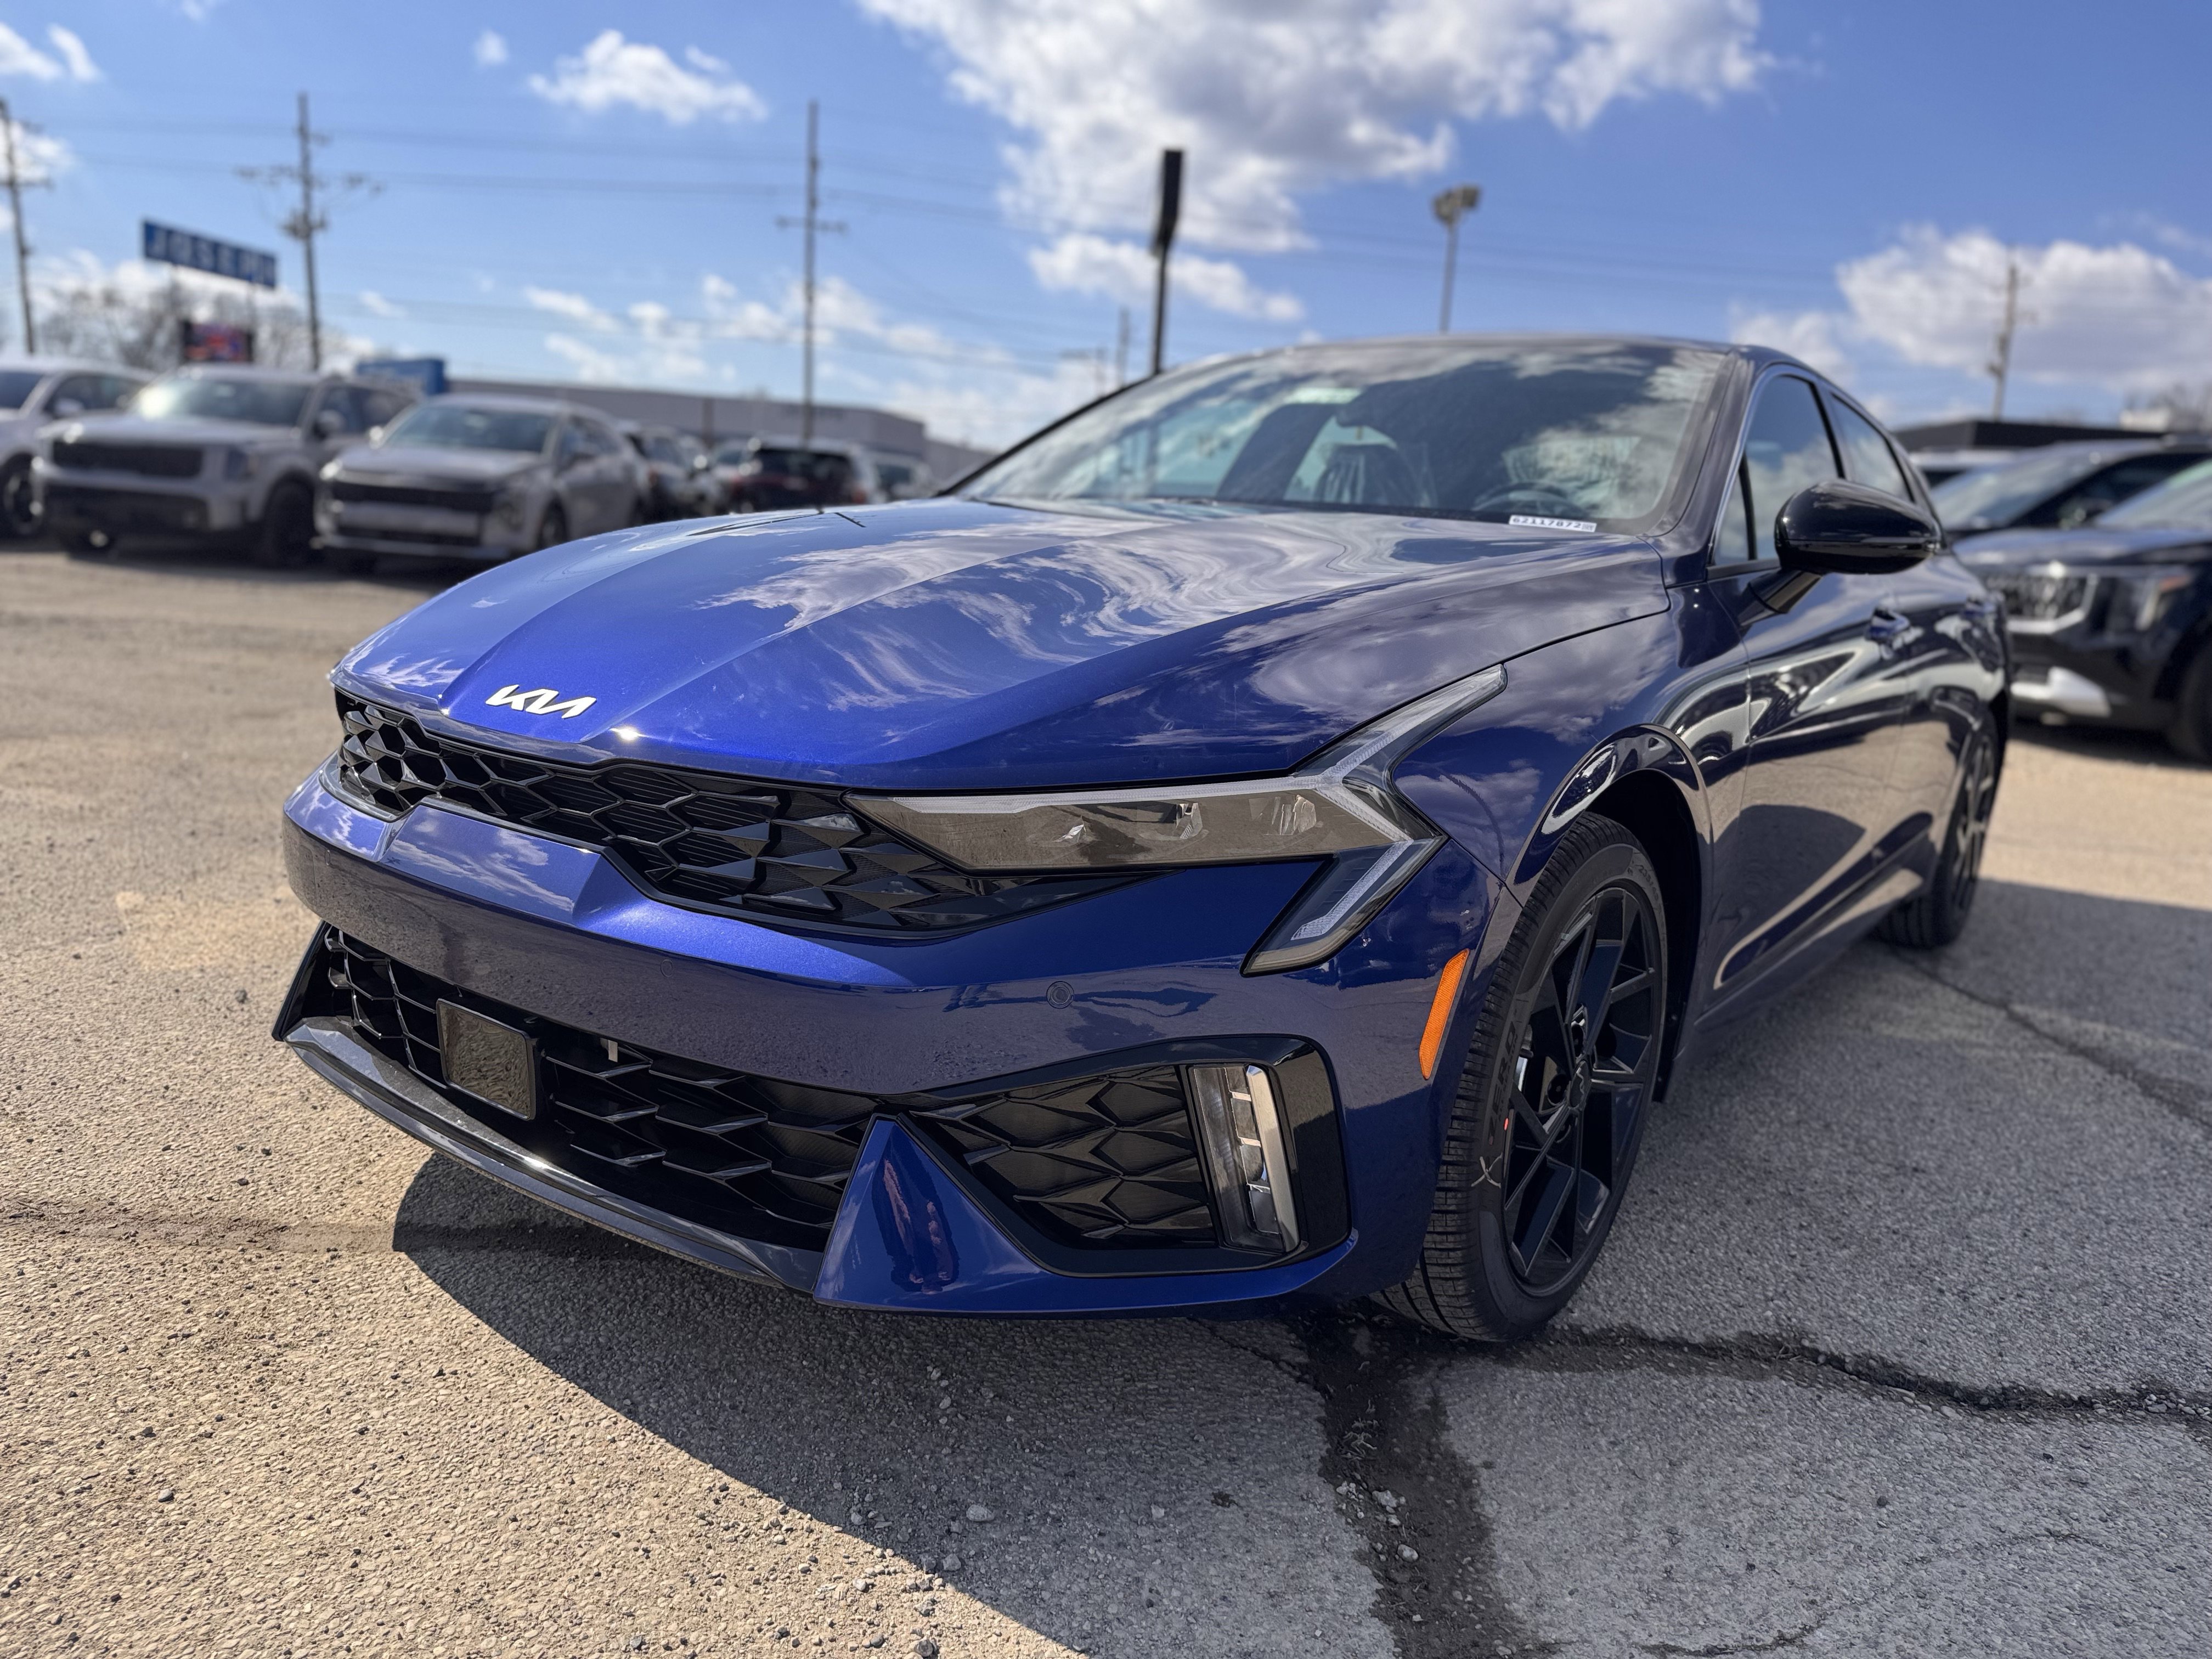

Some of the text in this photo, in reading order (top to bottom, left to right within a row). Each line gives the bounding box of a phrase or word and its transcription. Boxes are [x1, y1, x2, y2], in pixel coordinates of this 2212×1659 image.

[1513, 517, 1582, 528] 62117872
[485, 684, 597, 719] KIA
[1488, 1021, 1516, 1145] ZERO
